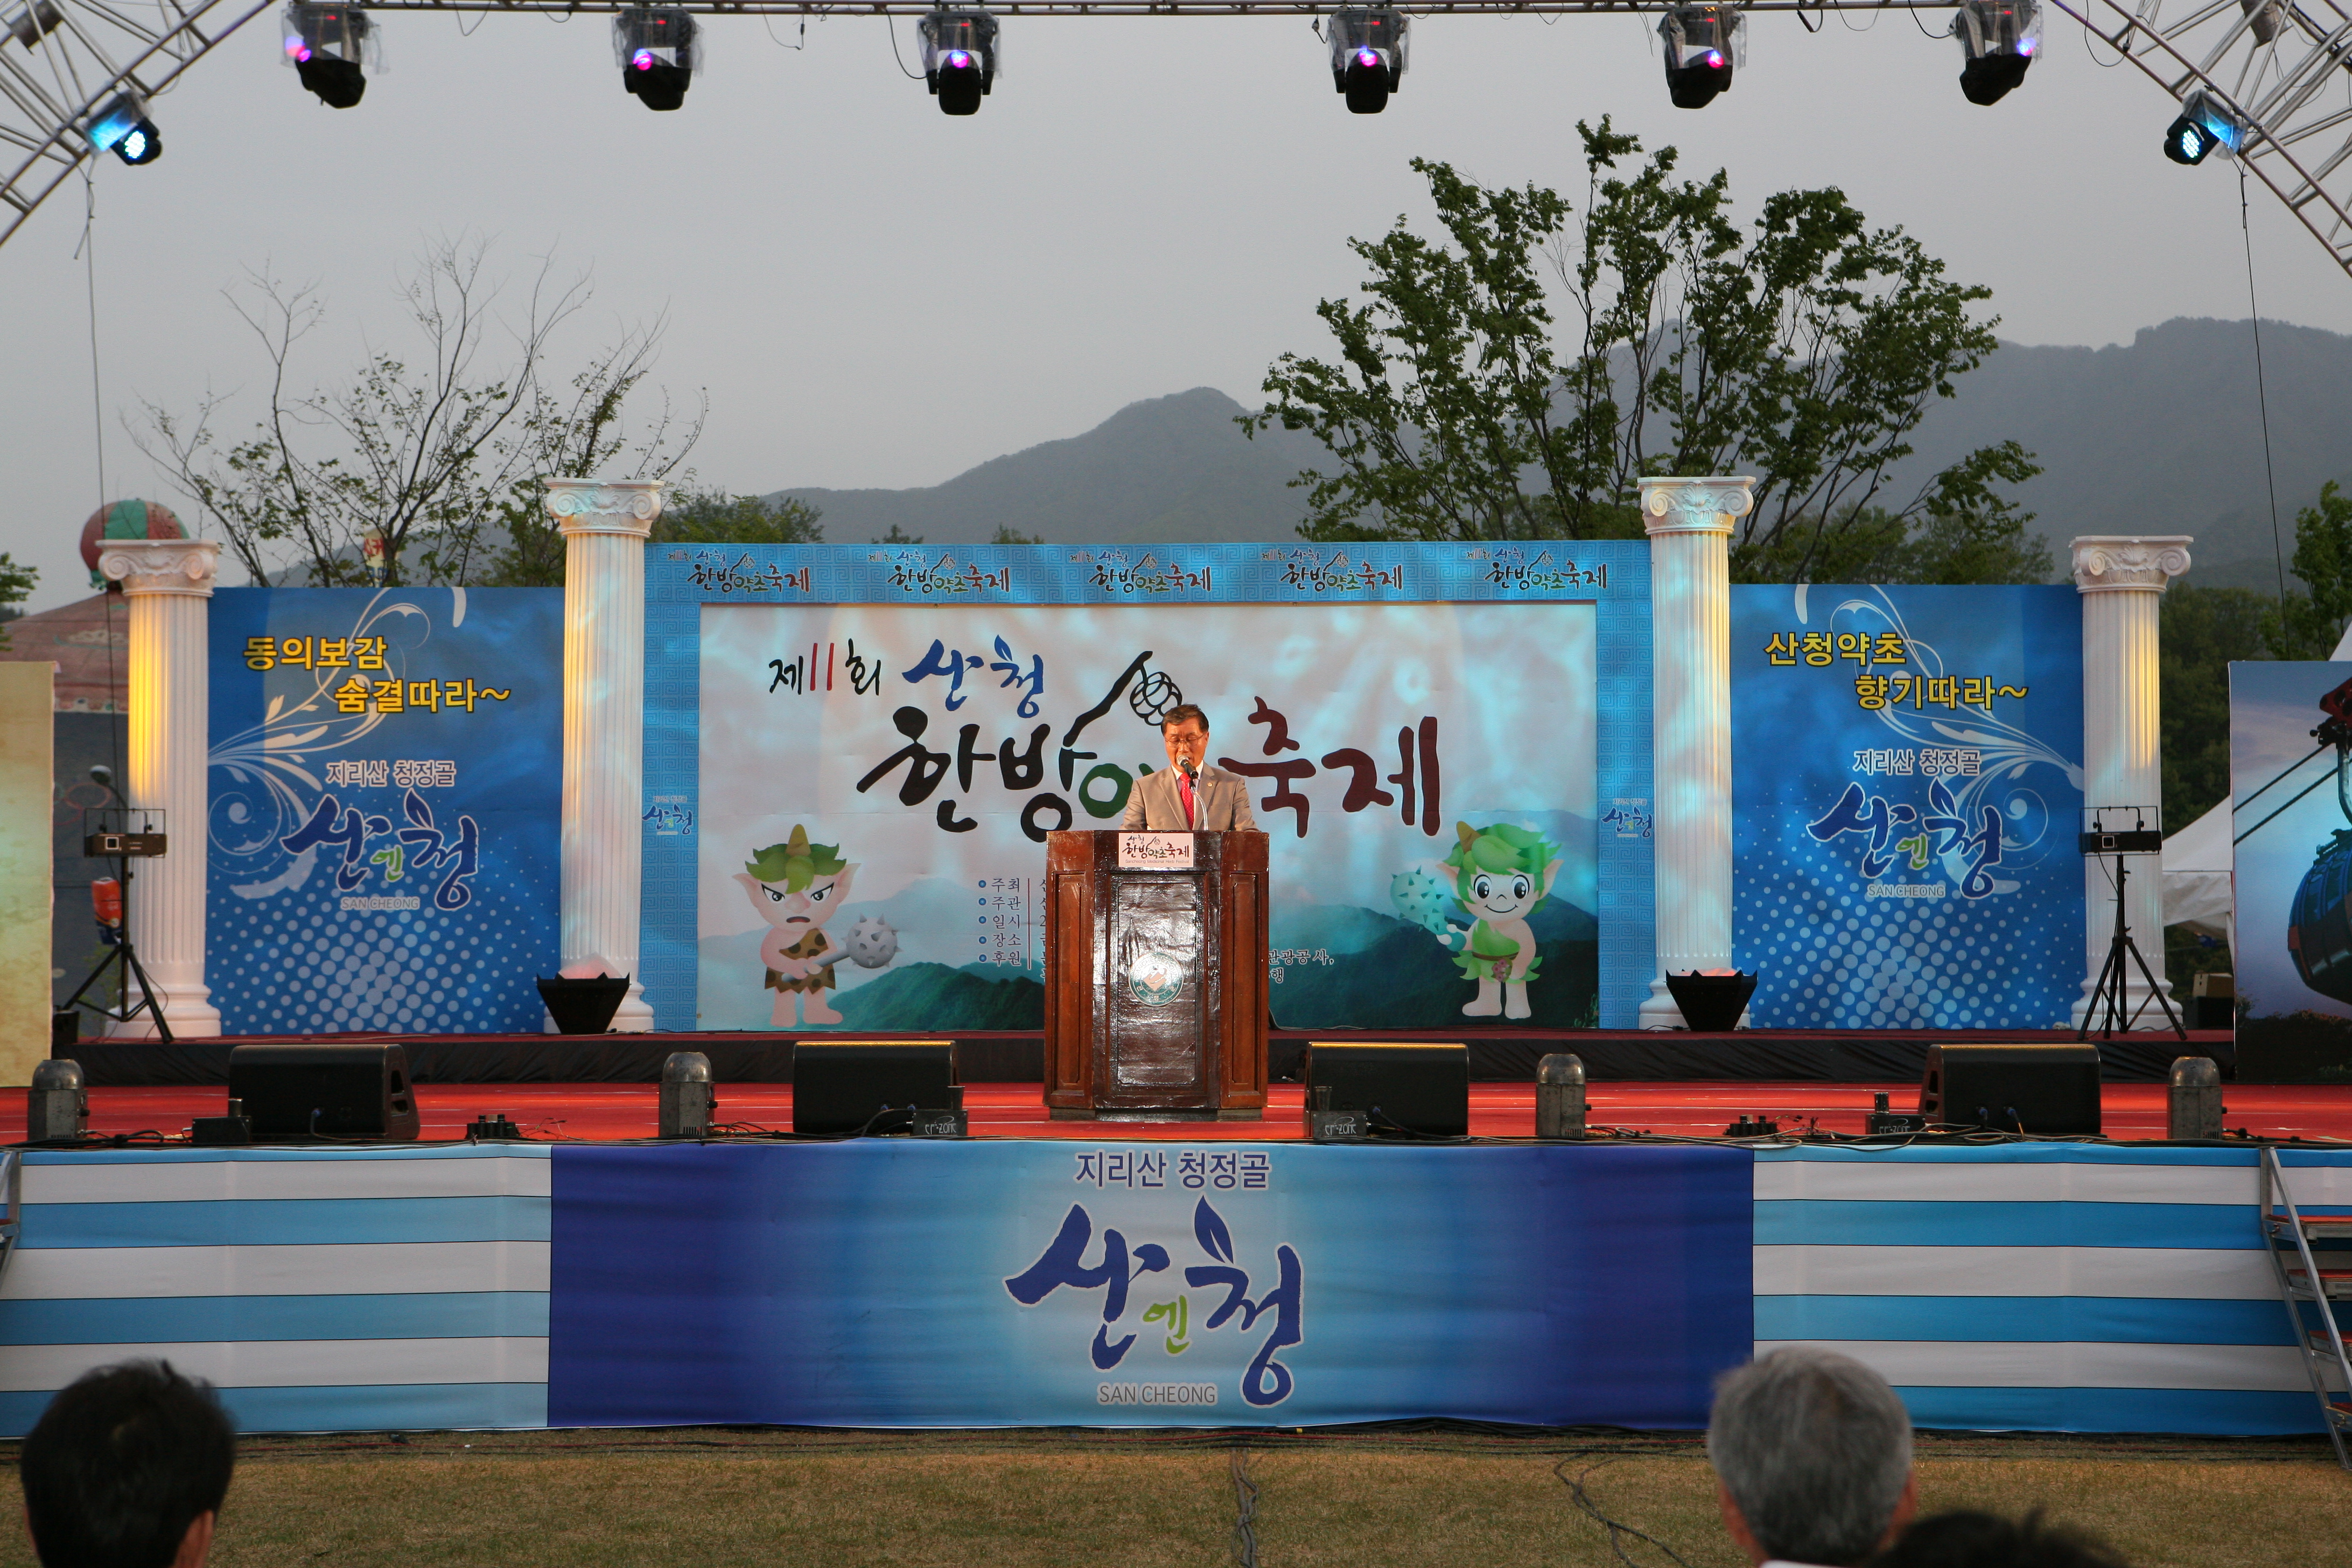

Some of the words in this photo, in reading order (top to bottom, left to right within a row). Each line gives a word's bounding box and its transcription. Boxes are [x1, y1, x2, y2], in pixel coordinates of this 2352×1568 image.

[696, 549, 726, 566] 산청
[896, 550, 926, 568] 산청
[1098, 549, 1128, 568] 산청
[1290, 548, 1319, 565] 산청
[1494, 547, 1524, 565] 산청
[687, 552, 810, 593] 한방약초축제
[887, 554, 1010, 594] 한방약초축제
[1088, 553, 1211, 593] 한방약초축제
[1280, 551, 1402, 592] 한방약초축제
[1485, 550, 1607, 591] 한방약초축제
[243, 636, 387, 670] 동의보감
[1763, 632, 1907, 666] 산청약초
[769, 638, 881, 695] 제11회
[902, 635, 1045, 718] 산청
[334, 678, 510, 713] 숨결따라~
[1855, 675, 2028, 710] 향기따라~
[326, 761, 388, 786] 지리산
[394, 761, 456, 786] 청정골
[1853, 750, 1914, 775] 지리산
[1920, 750, 1981, 775] 청정골
[1122, 836, 1189, 859] 한방약초축제
[991, 878, 1020, 893] 주최
[1868, 885, 1894, 897] SAN
[1896, 885, 1944, 897] CHEONG
[341, 897, 367, 909] SAN
[369, 897, 420, 909] CHEONG
[991, 896, 1021, 911] 주관
[993, 914, 1020, 929] 일시
[992, 933, 1021, 948] 장소
[992, 951, 1021, 966] 후원
[1076, 1151, 1167, 1188] 지리산
[1177, 1151, 1271, 1189] 청정골
[1099, 1385, 1136, 1403] SAN
[1142, 1385, 1216, 1403] CHEONG
